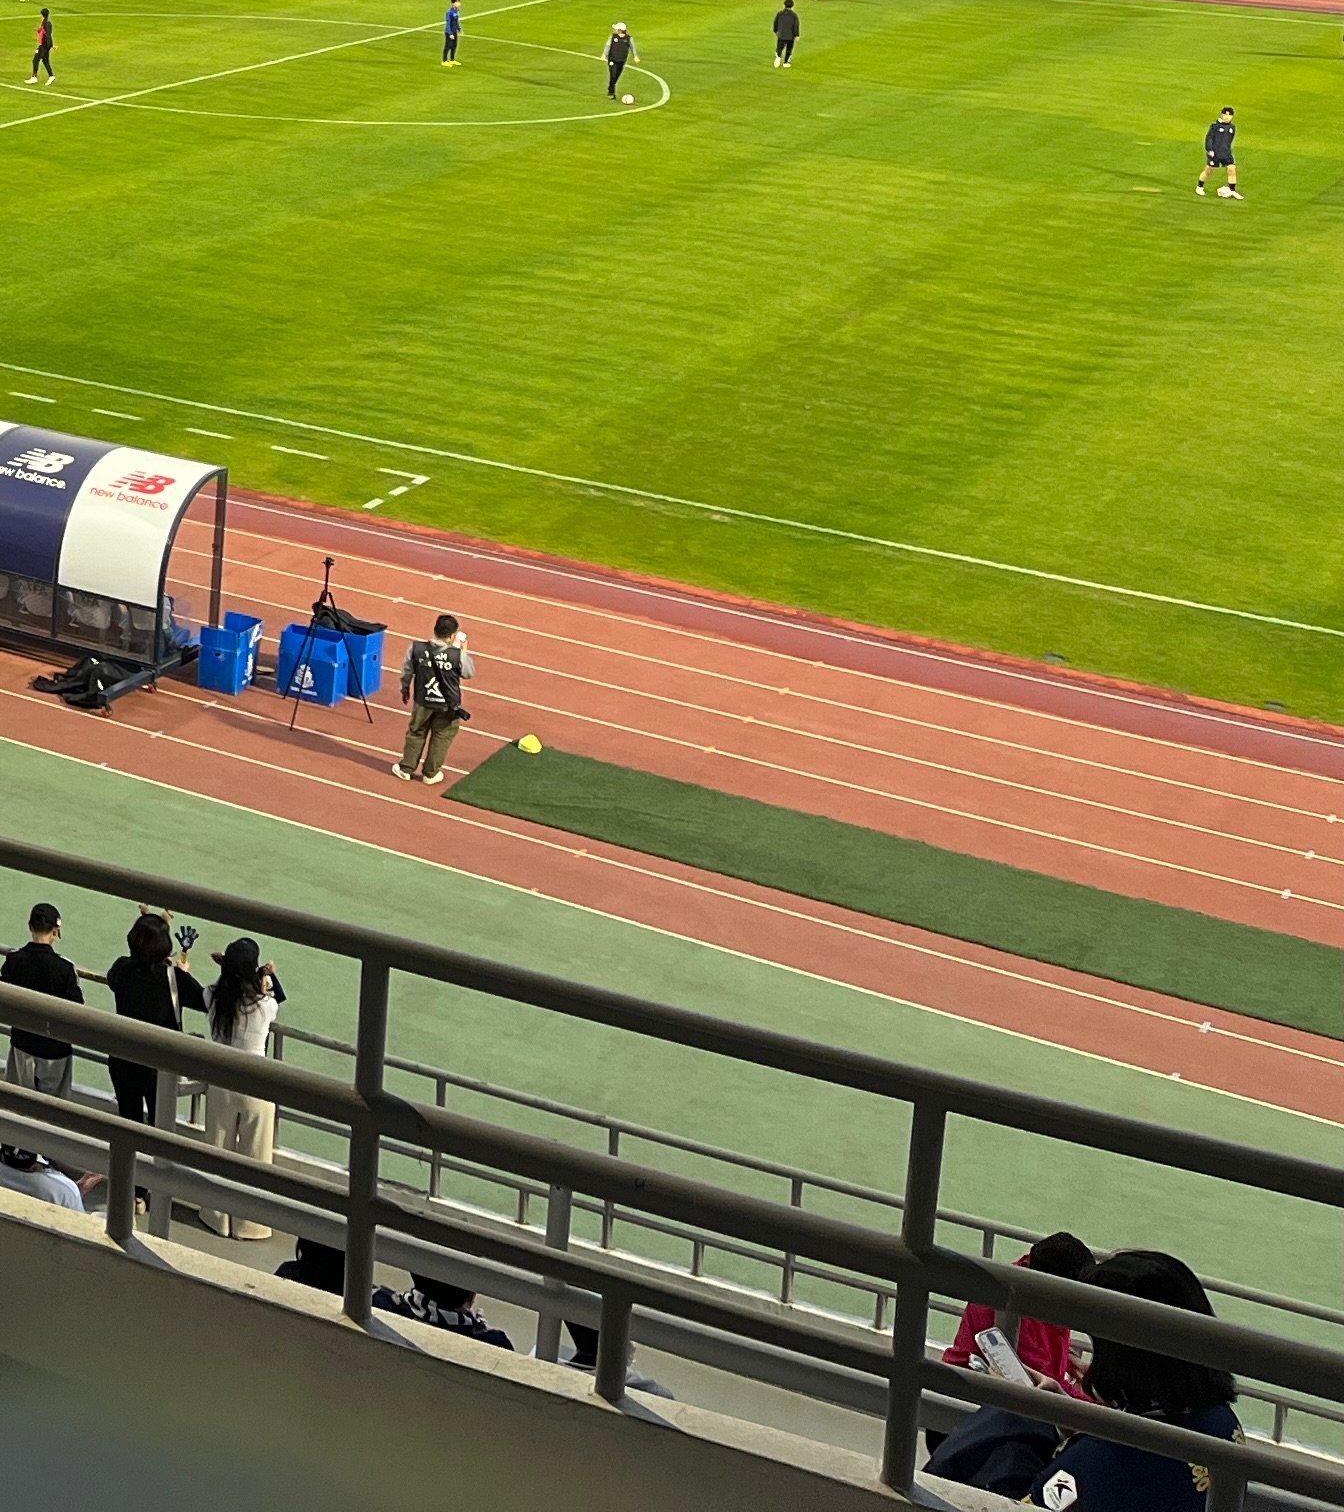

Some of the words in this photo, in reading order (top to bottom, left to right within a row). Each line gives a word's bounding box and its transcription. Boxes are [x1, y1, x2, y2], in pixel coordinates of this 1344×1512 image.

[14, 467, 66, 490] balance
[88, 485, 116, 500] new
[115, 489, 169, 512] balance
